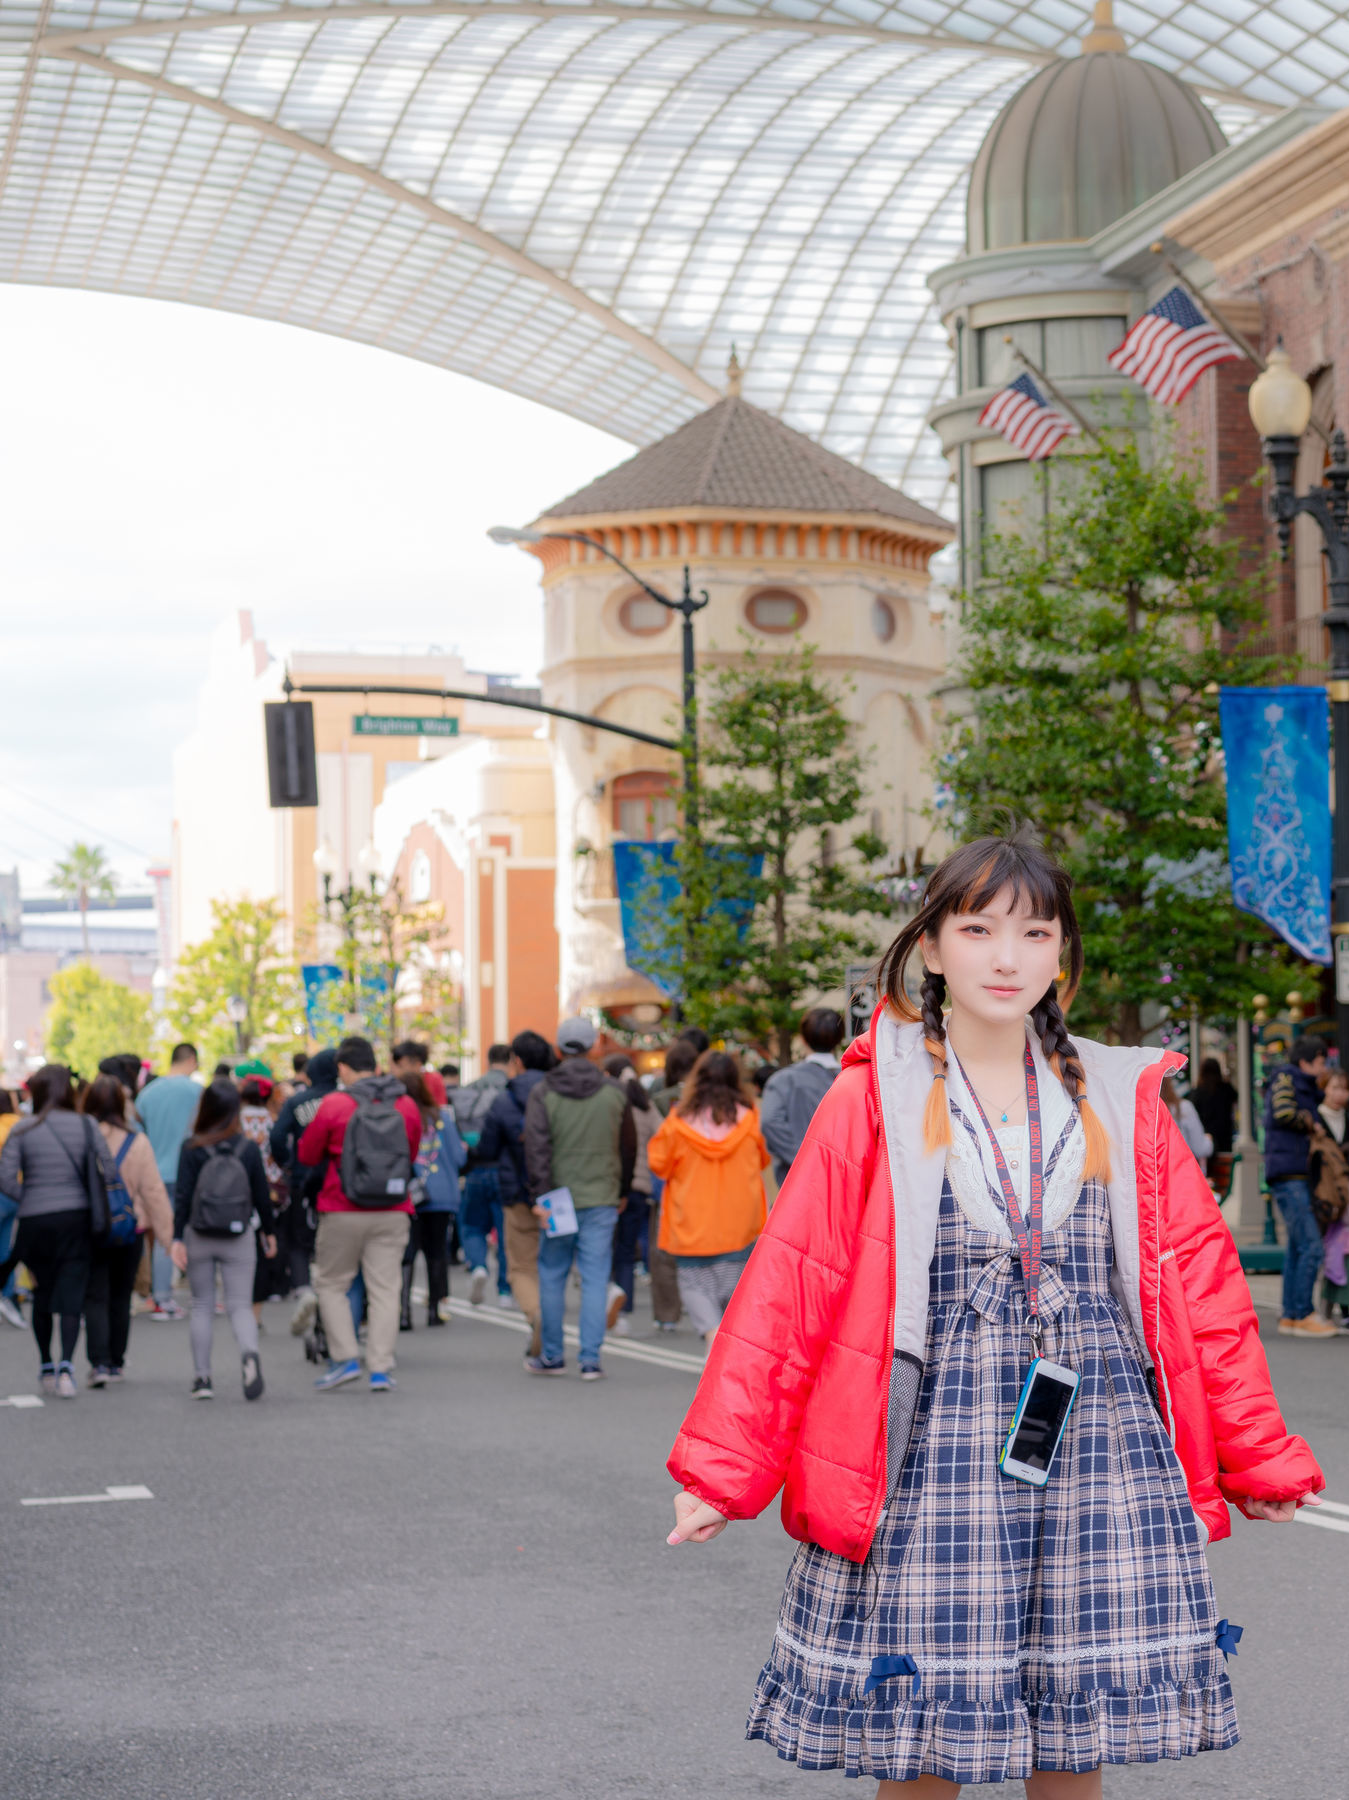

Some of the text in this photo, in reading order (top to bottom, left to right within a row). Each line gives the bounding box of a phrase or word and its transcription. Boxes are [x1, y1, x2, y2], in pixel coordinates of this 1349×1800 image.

[422, 719, 451, 734] Way
[1026, 1073, 1039, 1111] UN NERV
[991, 1143, 1007, 1169] NERV
[1029, 1120, 1042, 1163] UN NERV
[1001, 1179, 1023, 1223] UN NERV
[1031, 1173, 1042, 1218] UN NERV
[1017, 1233, 1029, 1249] UN
[1031, 1228, 1042, 1276] UN NERV
